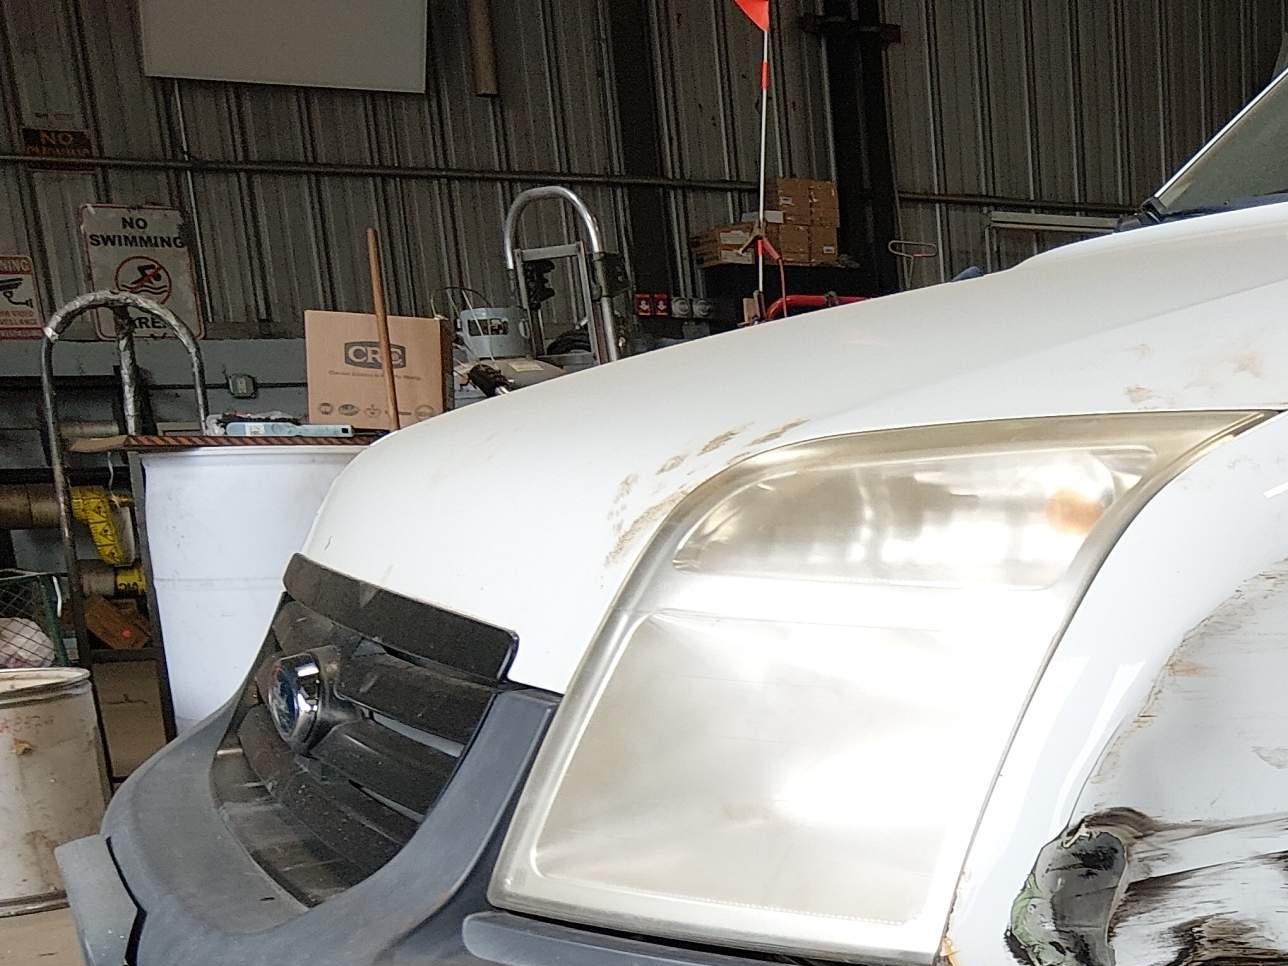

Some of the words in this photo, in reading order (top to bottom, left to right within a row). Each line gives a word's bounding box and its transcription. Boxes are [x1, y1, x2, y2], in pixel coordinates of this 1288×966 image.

[121, 217, 148, 230] NO
[89, 234, 185, 249] SWIMMING
[348, 345, 404, 364] CRC
